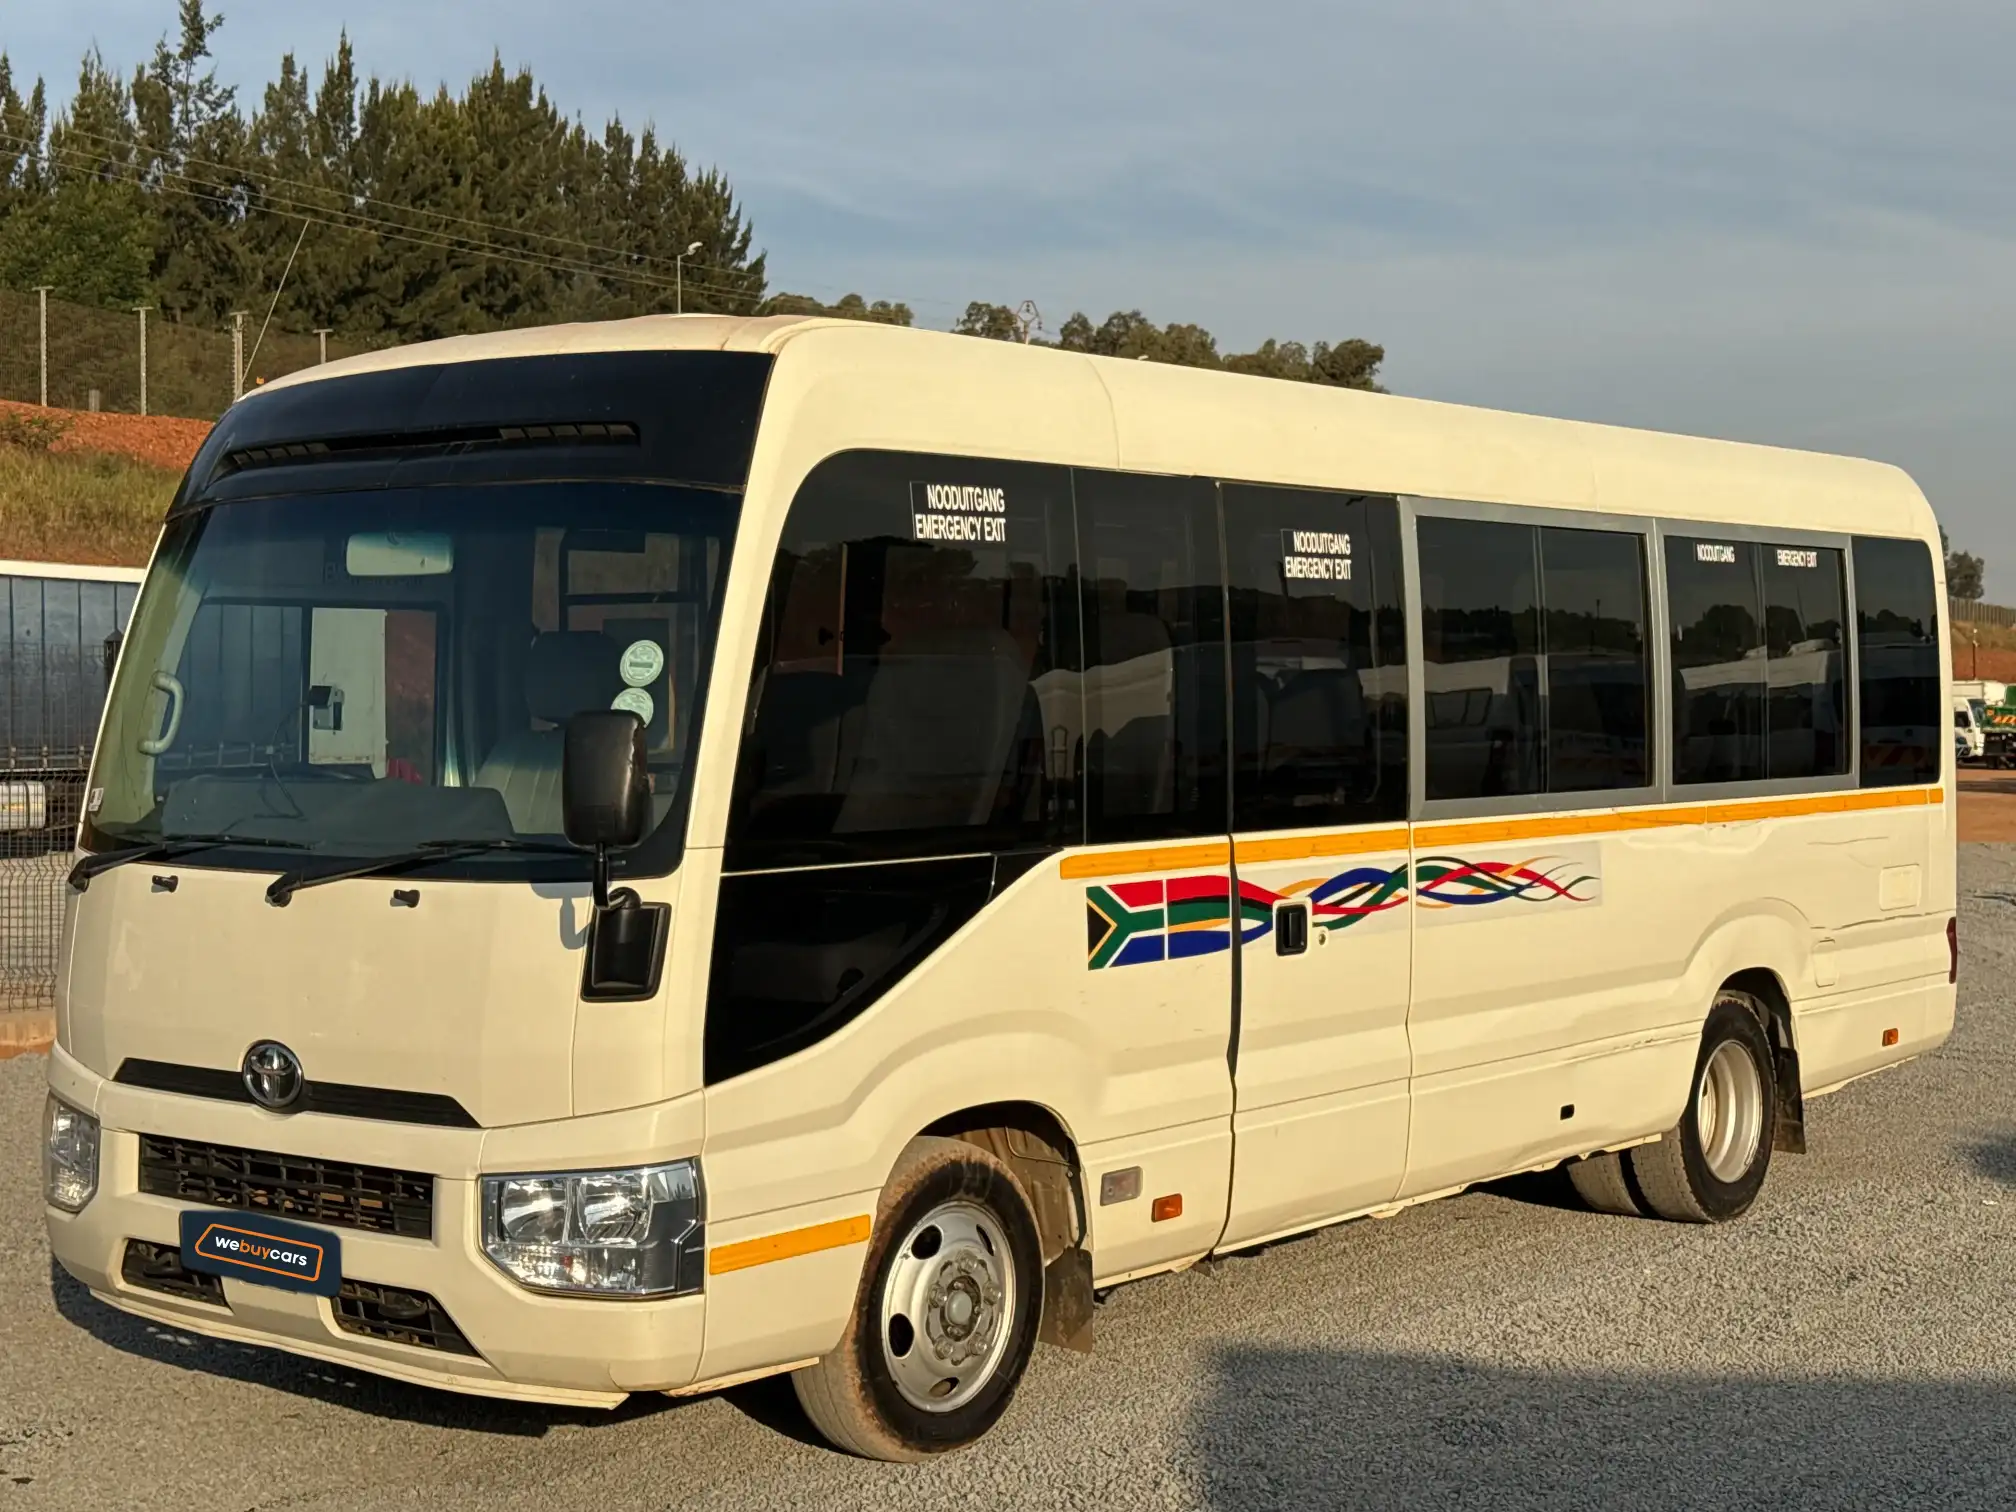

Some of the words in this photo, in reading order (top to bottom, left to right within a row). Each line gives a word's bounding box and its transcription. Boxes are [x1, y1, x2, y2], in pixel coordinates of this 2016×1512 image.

[927, 484, 1005, 513] NOODUITGANG
[915, 514, 982, 541] EMERGENCY
[984, 517, 1006, 542] EXIT
[1293, 531, 1351, 555] NOODUITGANG
[1285, 556, 1334, 579] EMERGENCY
[1335, 558, 1352, 580] EXIT
